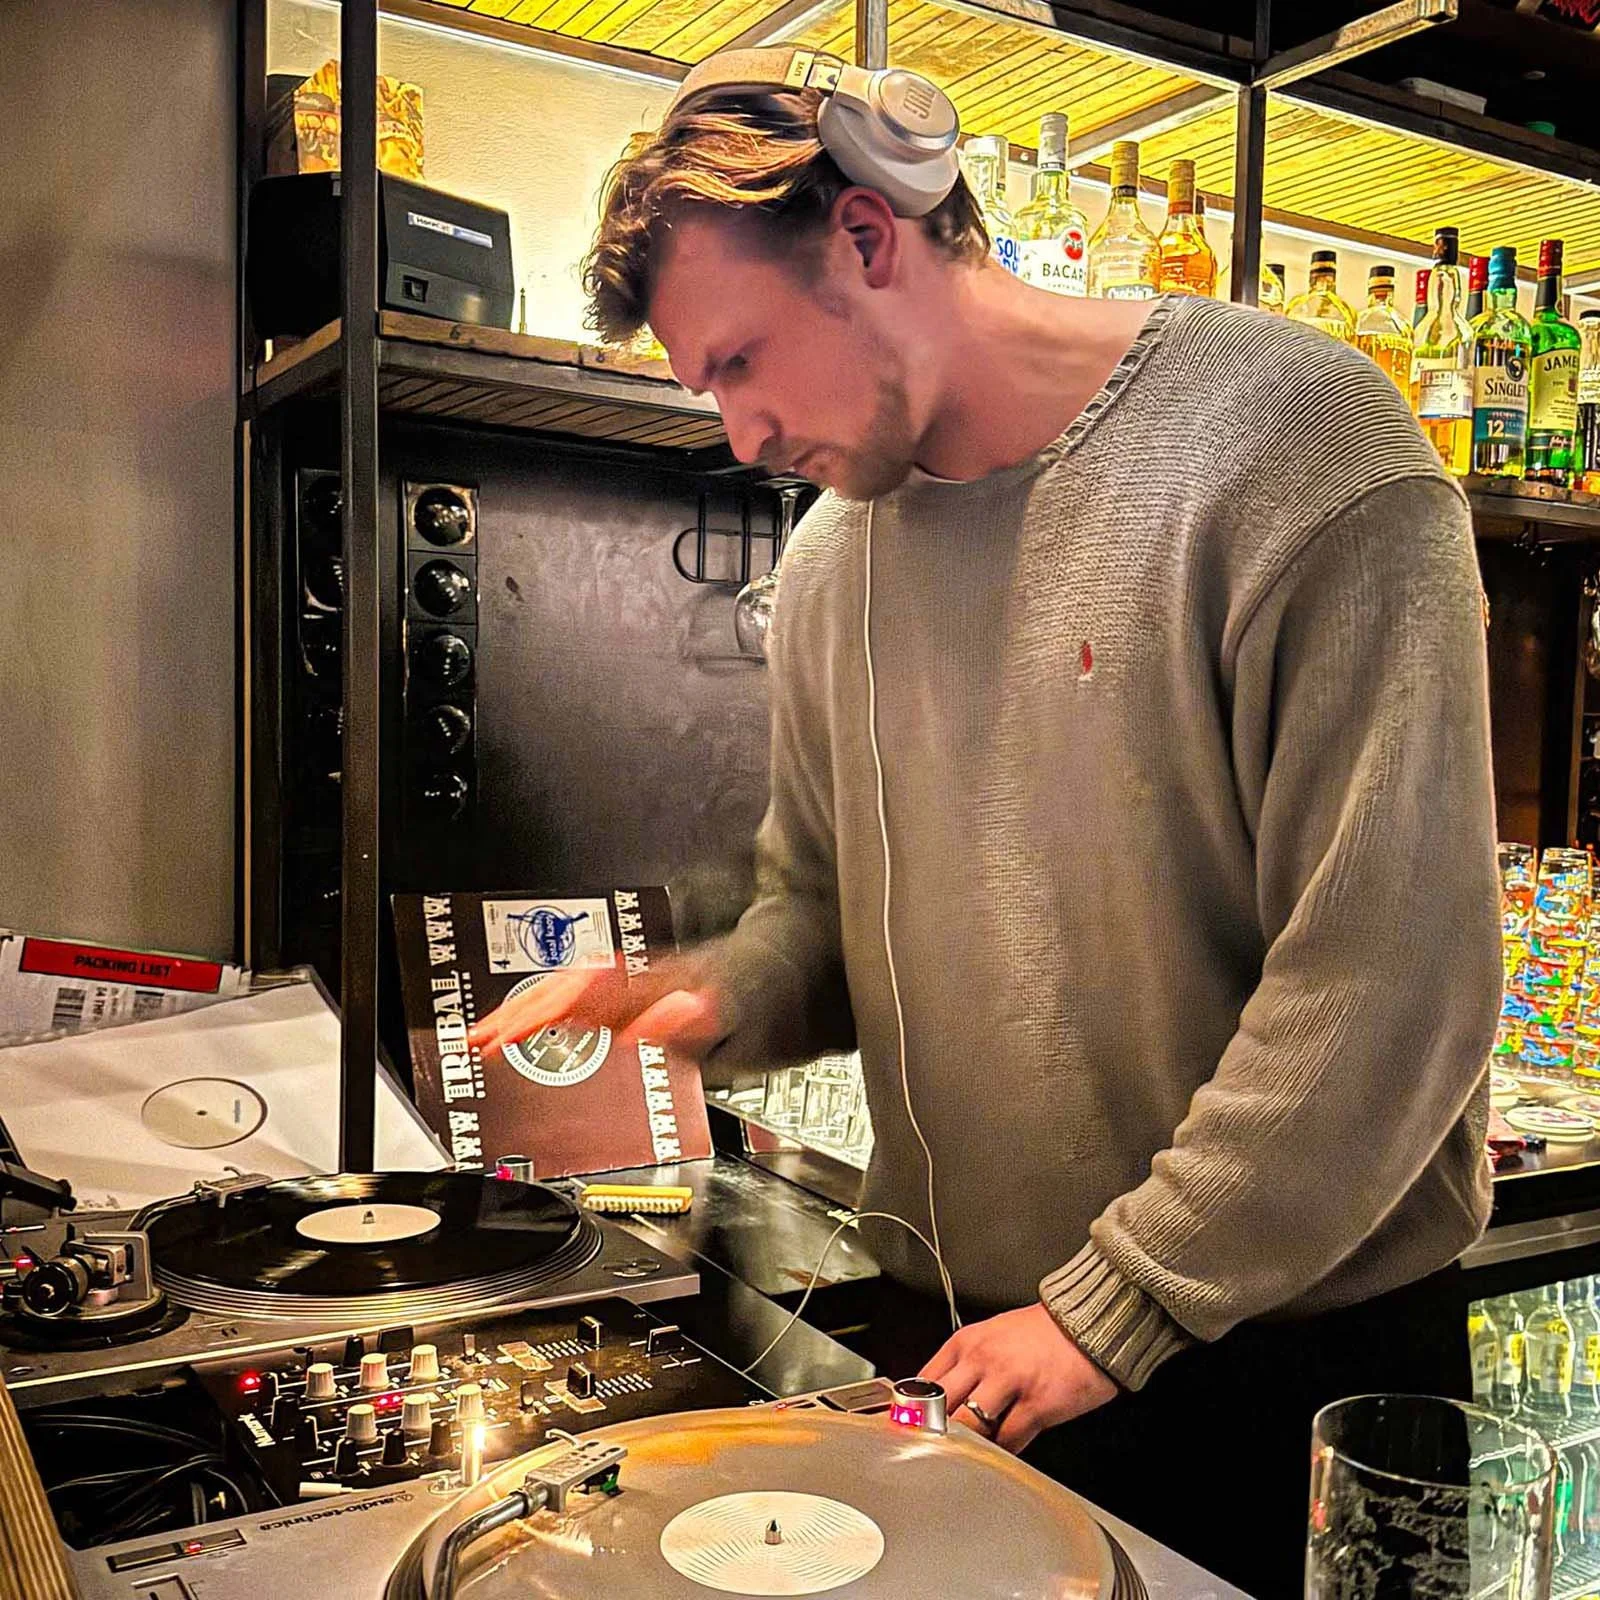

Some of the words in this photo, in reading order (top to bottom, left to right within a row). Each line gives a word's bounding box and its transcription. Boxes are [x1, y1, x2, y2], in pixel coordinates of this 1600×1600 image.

[902, 86, 936, 119] JBL
[1487, 420, 1504, 437] 12
[73, 955, 137, 973] PACKING
[140, 963, 172, 977] LIST
[431, 970, 475, 1103] TRIBAL
[259, 1497, 398, 1531] audio-technica
